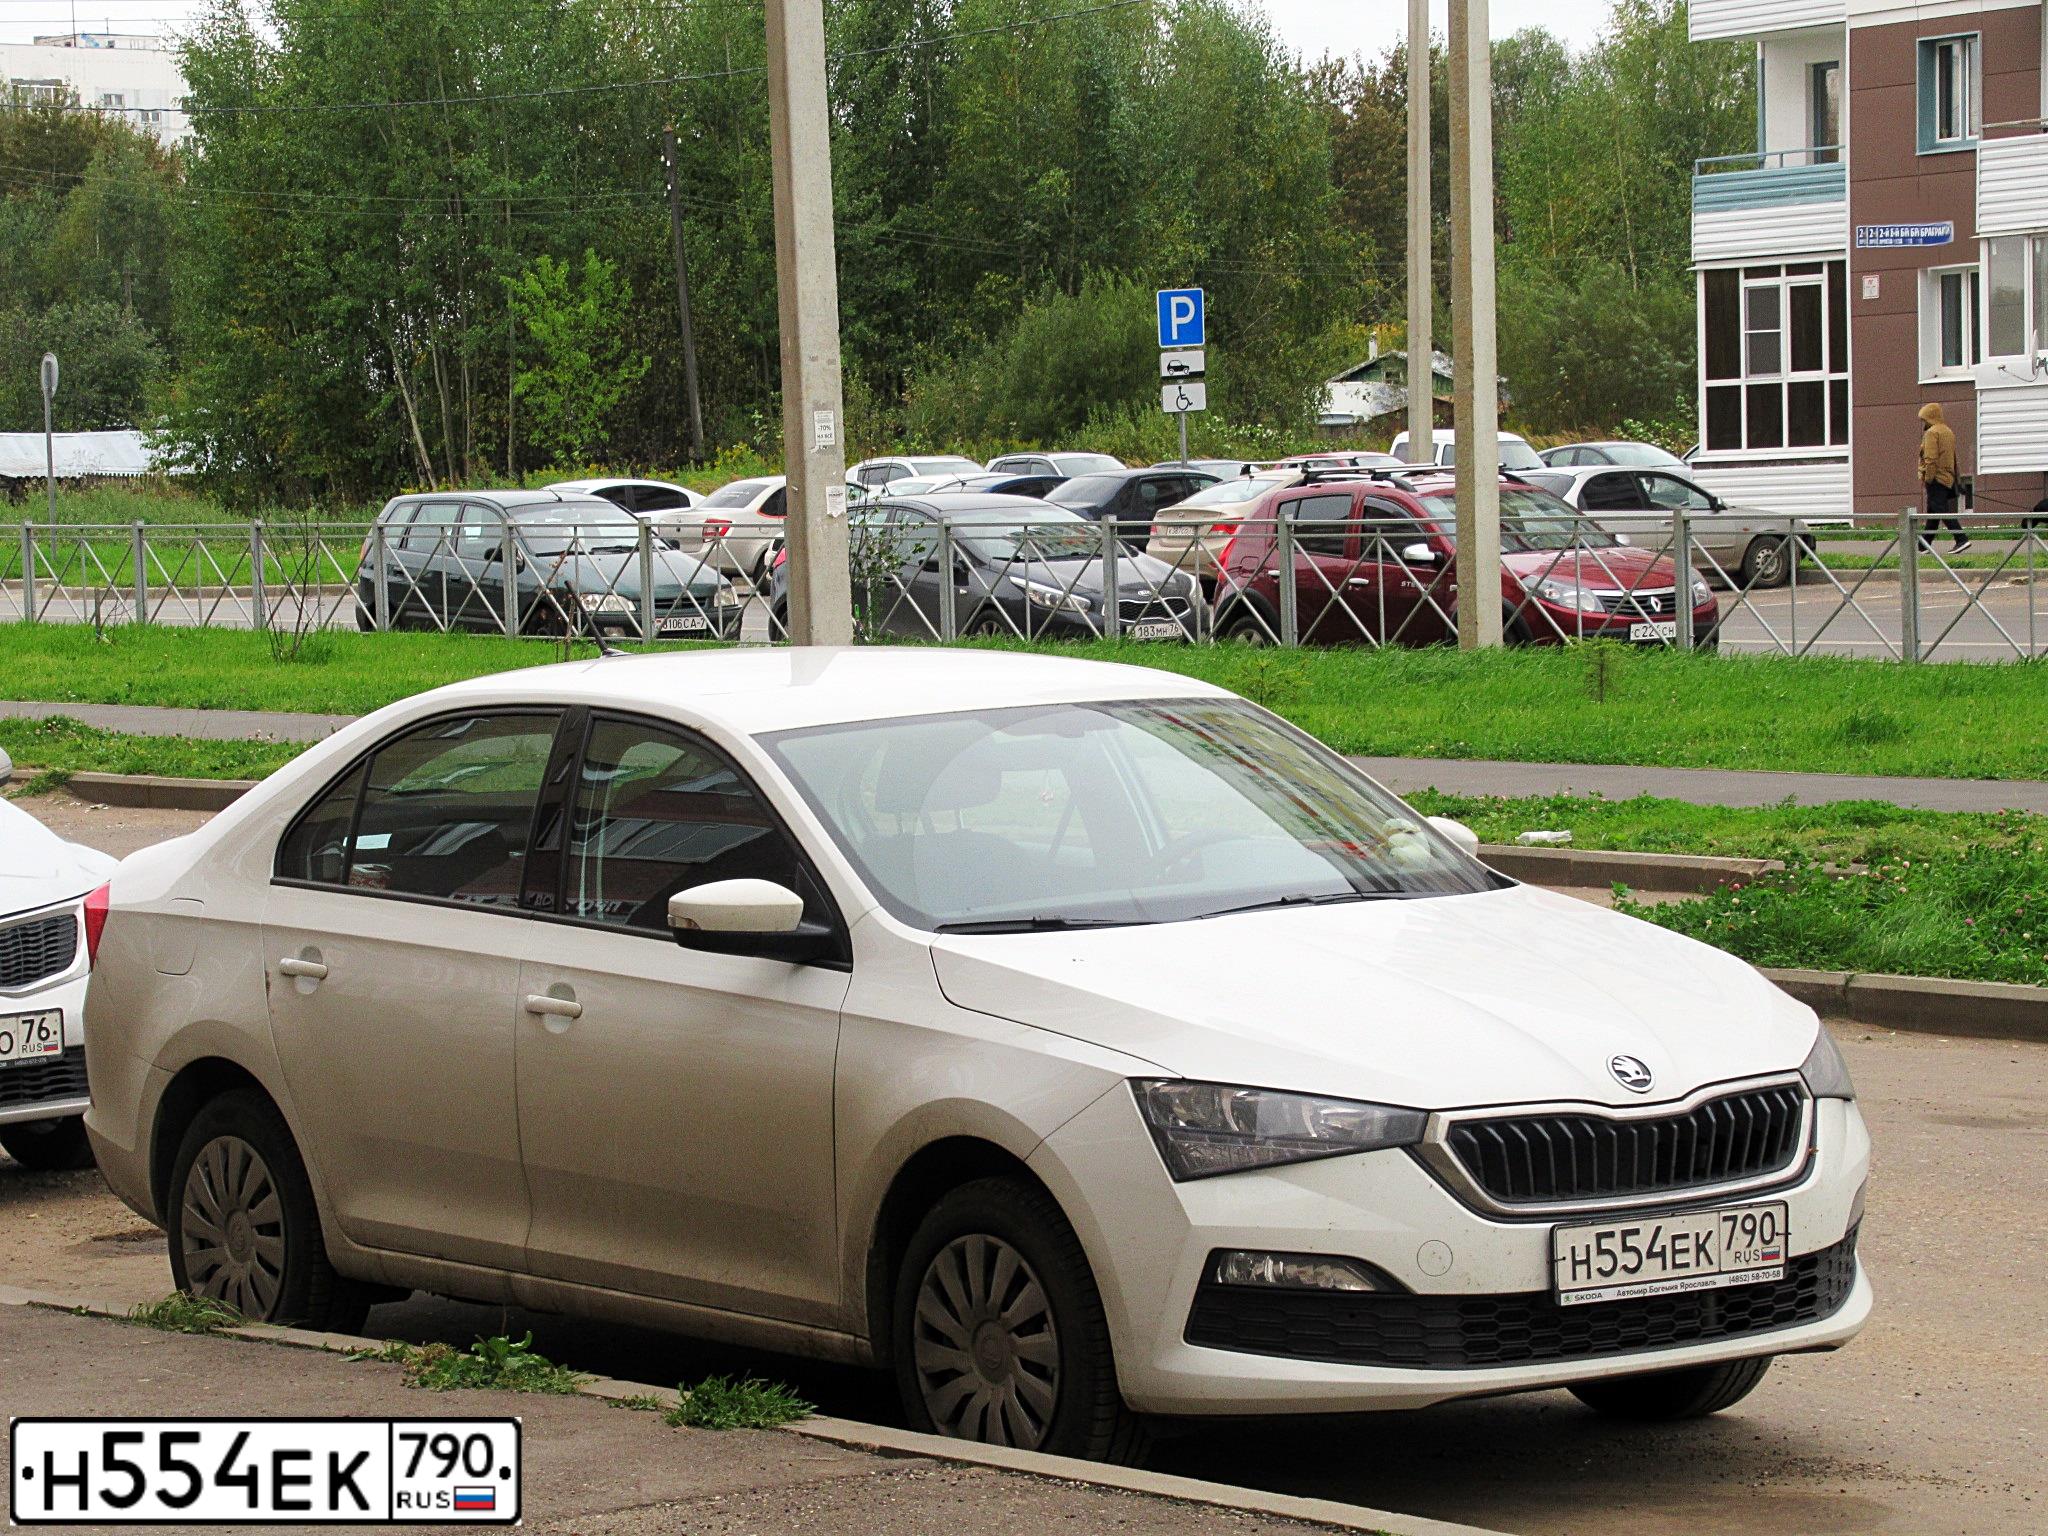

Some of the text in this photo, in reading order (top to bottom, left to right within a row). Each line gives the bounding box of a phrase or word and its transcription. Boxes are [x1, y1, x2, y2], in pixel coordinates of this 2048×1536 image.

[1170, 295, 1196, 340] P
[1634, 625, 1674, 638] С22СН
[22, 1016, 50, 1044] 76
[21, 1043, 43, 1054] RUS
[1570, 1210, 1776, 1281] Н554ЕК 790
[1734, 1249, 1760, 1264] RUS
[1616, 1288, 1648, 1297] Автомир
[1648, 1284, 1679, 1294] Богемия
[1680, 1280, 1717, 1291] Ярославль
[1728, 1275, 1750, 1285] (4852)
